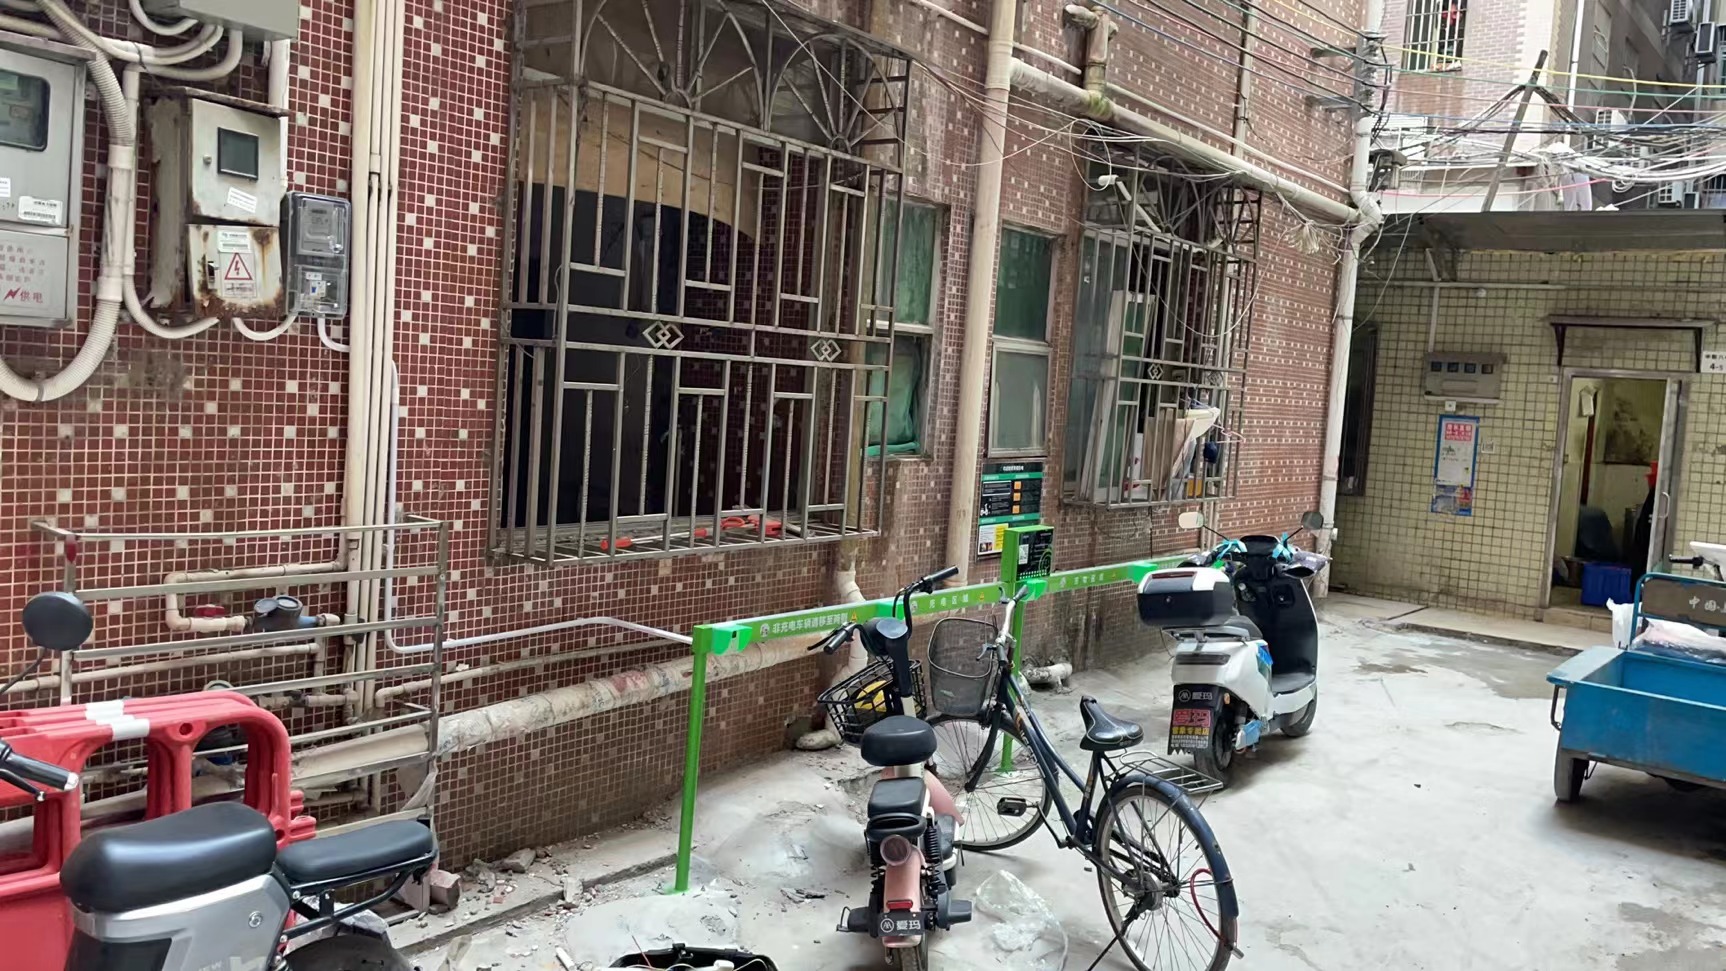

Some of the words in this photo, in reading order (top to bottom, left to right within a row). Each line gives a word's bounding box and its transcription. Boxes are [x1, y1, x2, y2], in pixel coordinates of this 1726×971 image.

[20, 290, 43, 303] 供电
[929, 593, 969, 609] 充电区域
[1191, 691, 1213, 700] 爱玛
[896, 919, 921, 931] 爱玛
